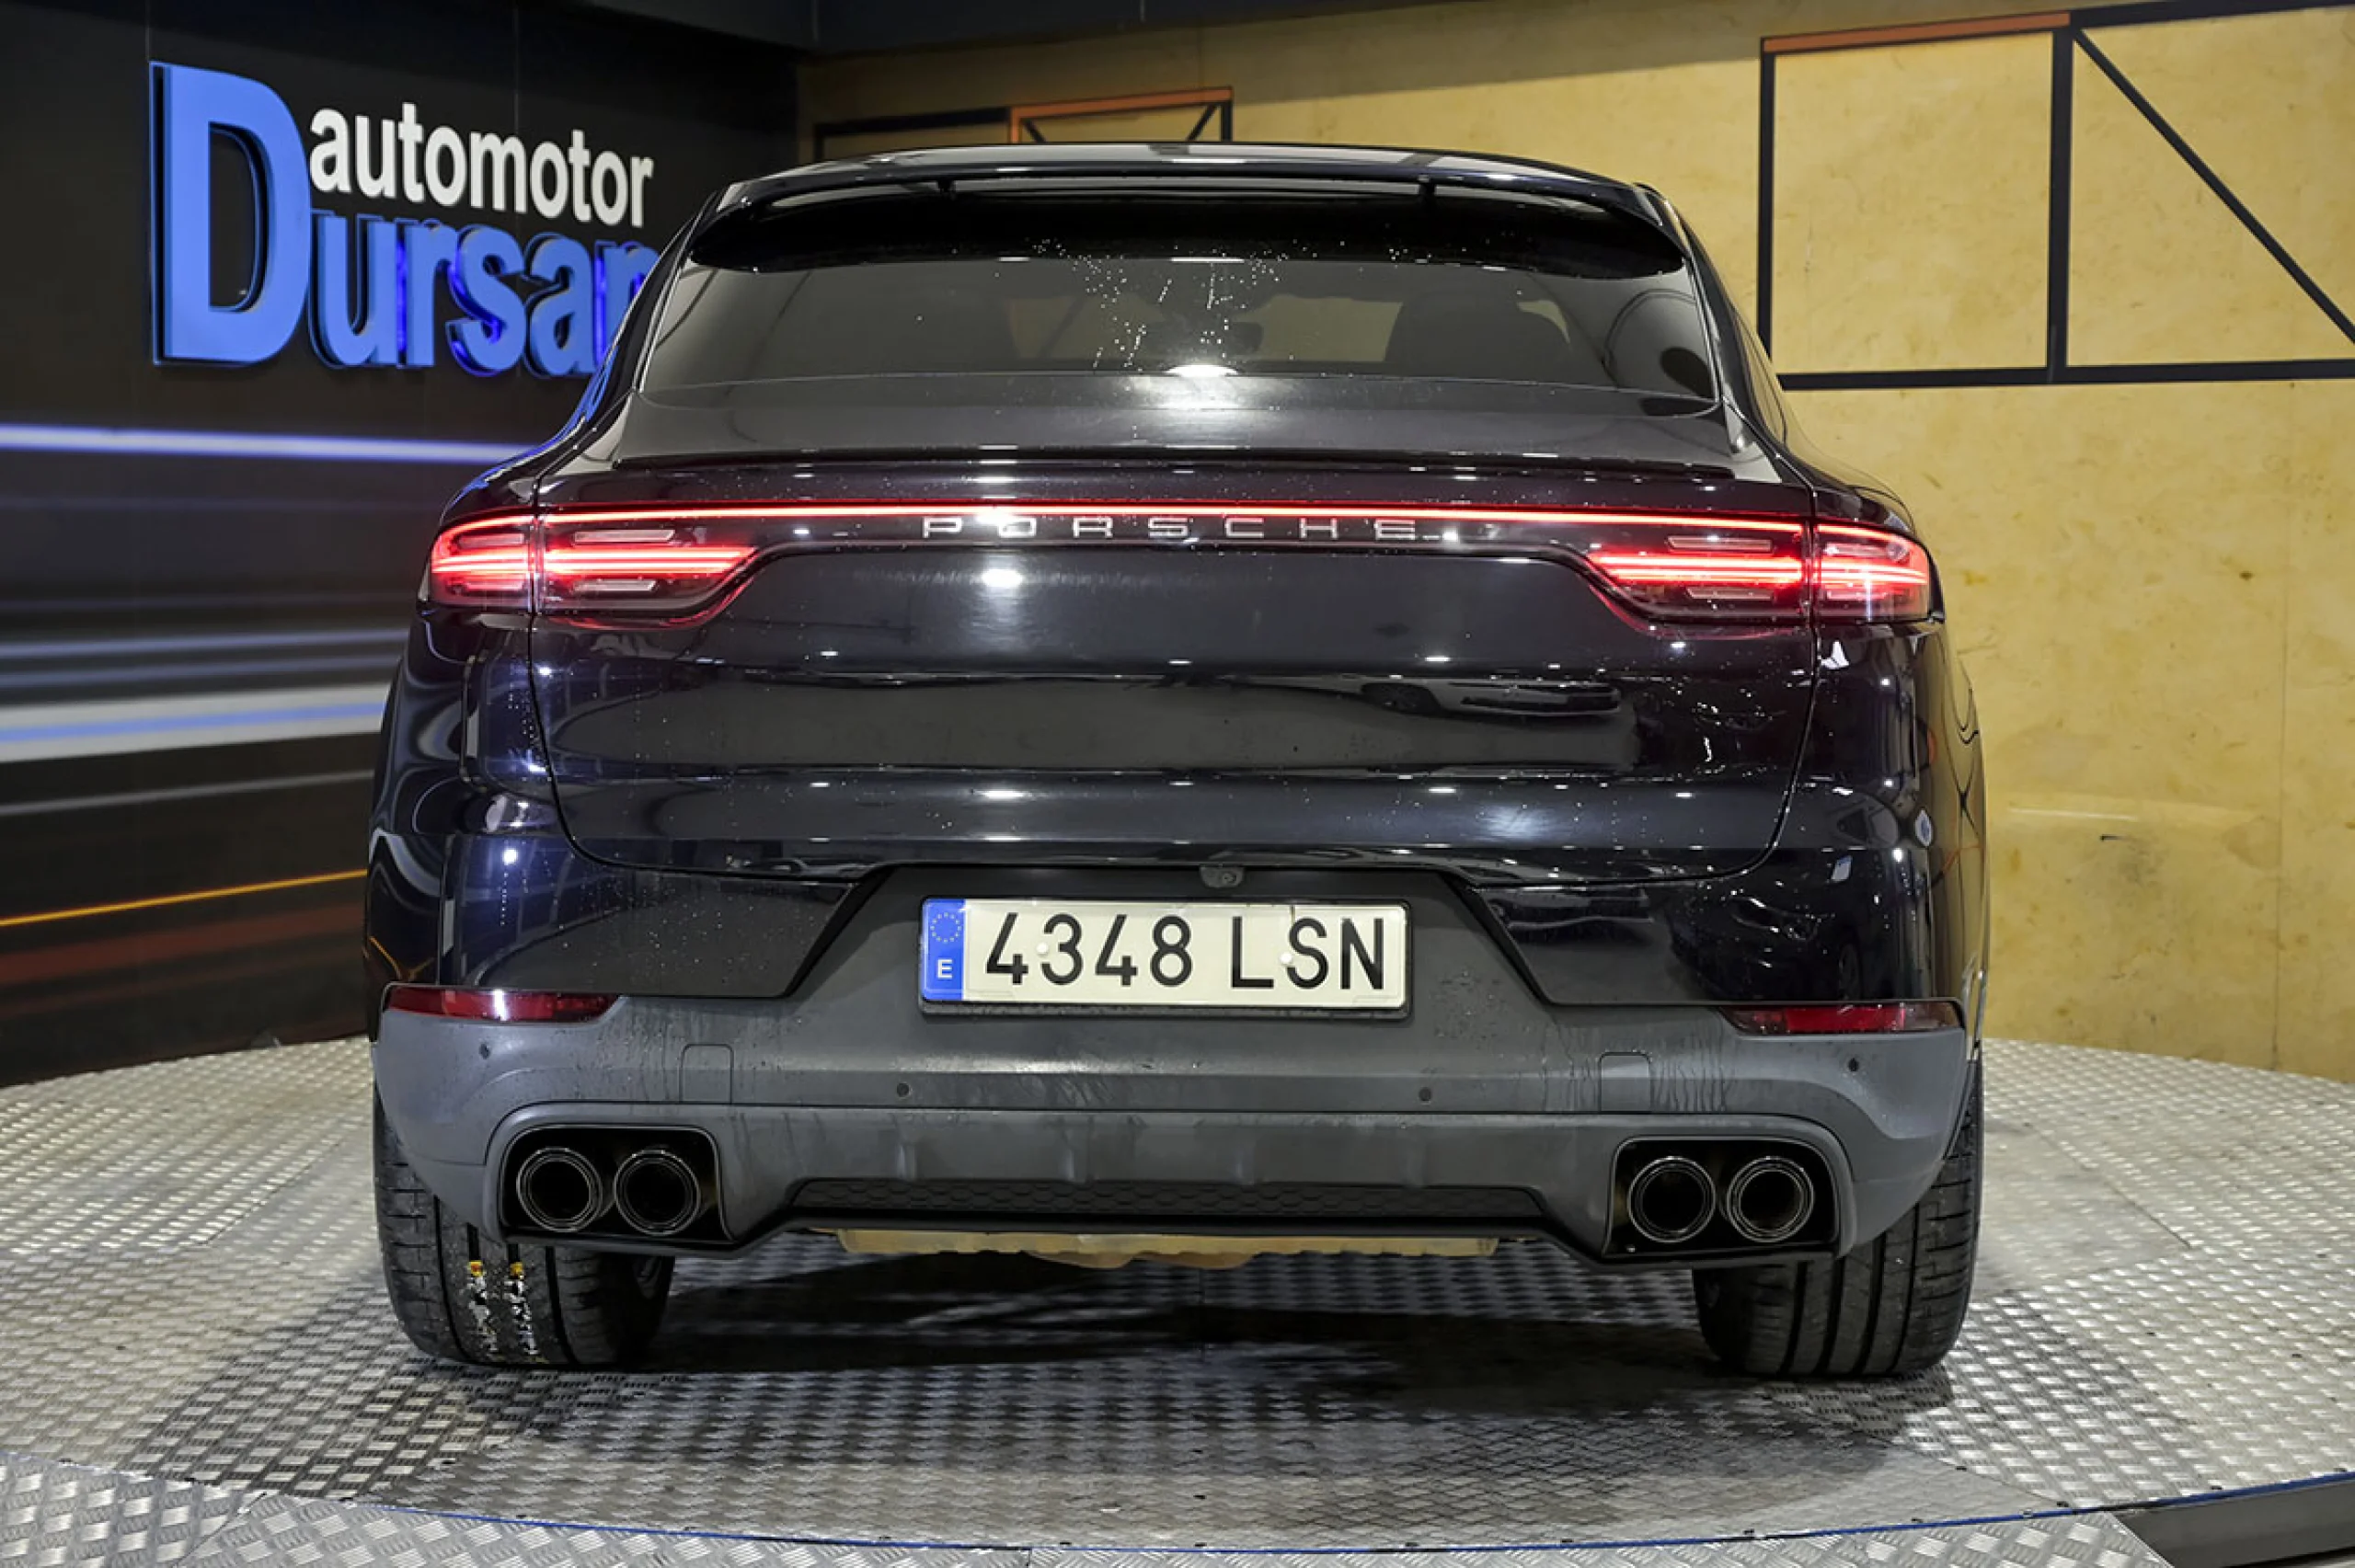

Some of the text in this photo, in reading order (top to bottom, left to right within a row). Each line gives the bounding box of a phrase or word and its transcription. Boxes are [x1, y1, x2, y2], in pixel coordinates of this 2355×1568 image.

[309, 102, 653, 227] automotor
[922, 515, 1417, 540] PORSCHE
[936, 958, 953, 979] E
[985, 912, 1384, 990] 4348 LSN
